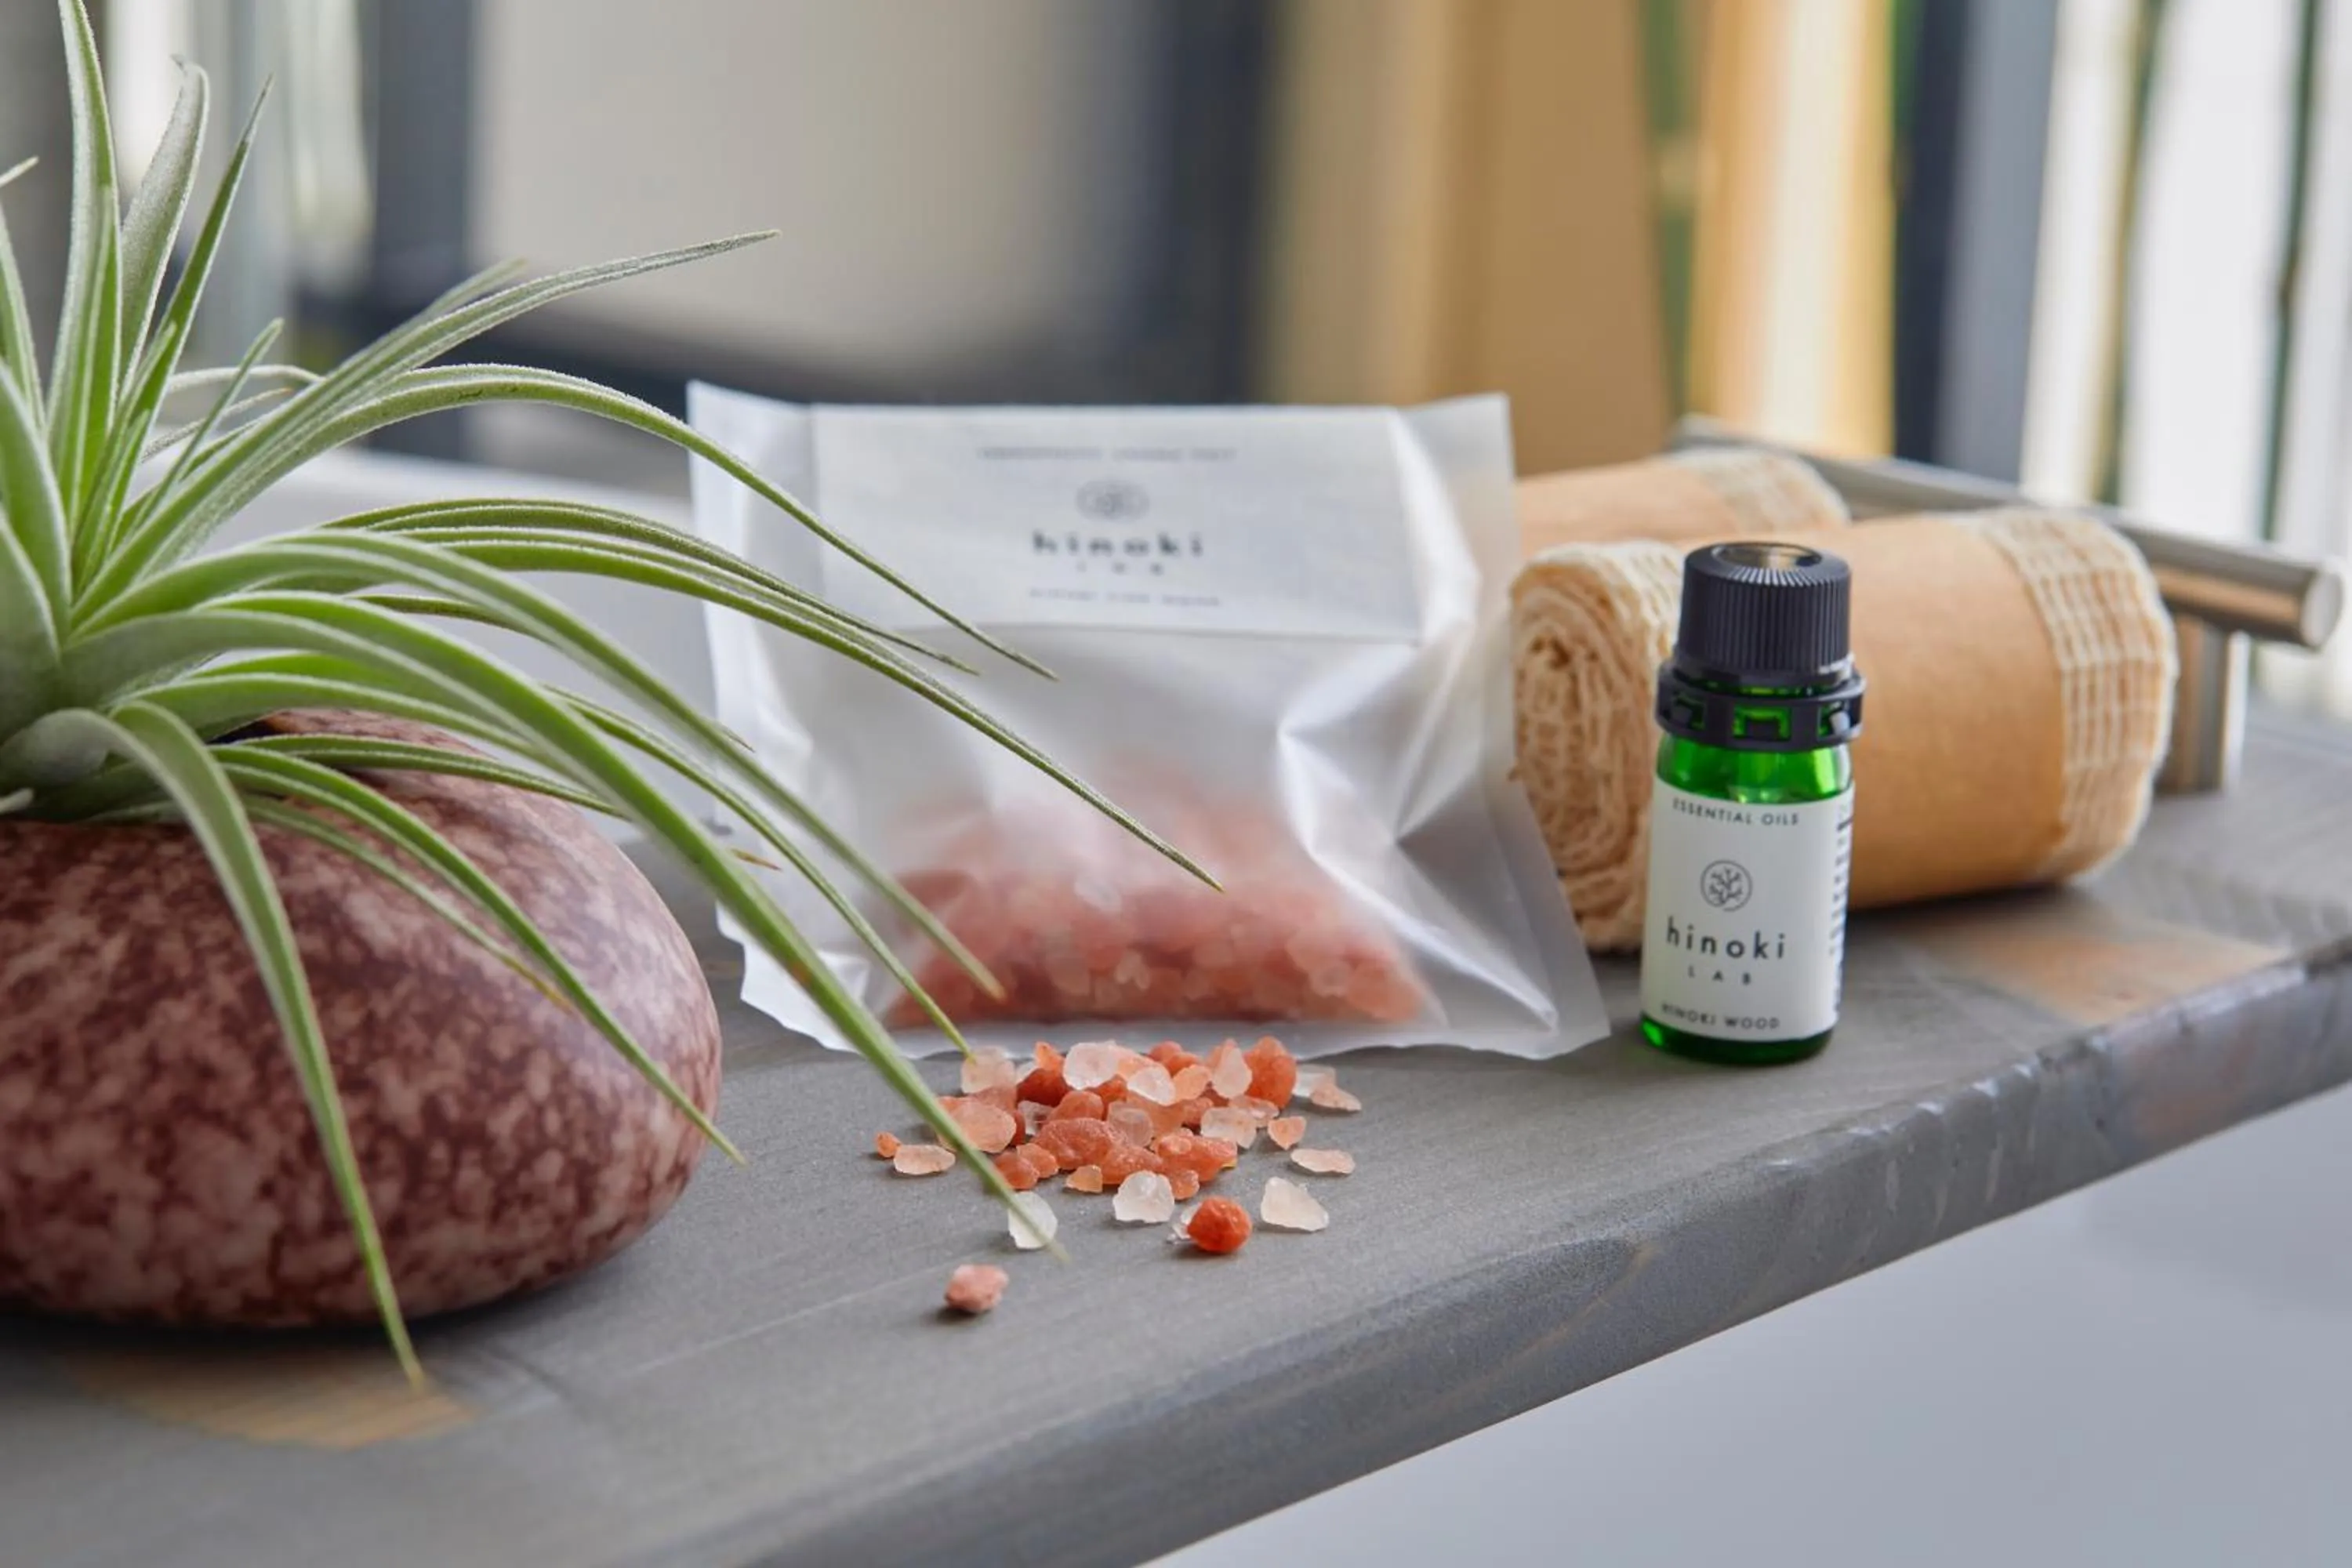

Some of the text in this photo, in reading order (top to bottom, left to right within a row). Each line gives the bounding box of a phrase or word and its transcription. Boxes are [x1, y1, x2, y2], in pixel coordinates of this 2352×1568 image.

[1031, 528, 1204, 558] hinoki
[1671, 797, 1799, 826] ESSENTIAL OILS
[1667, 915, 1786, 960] hinoki
[1725, 1017, 1780, 1030] WOOD
